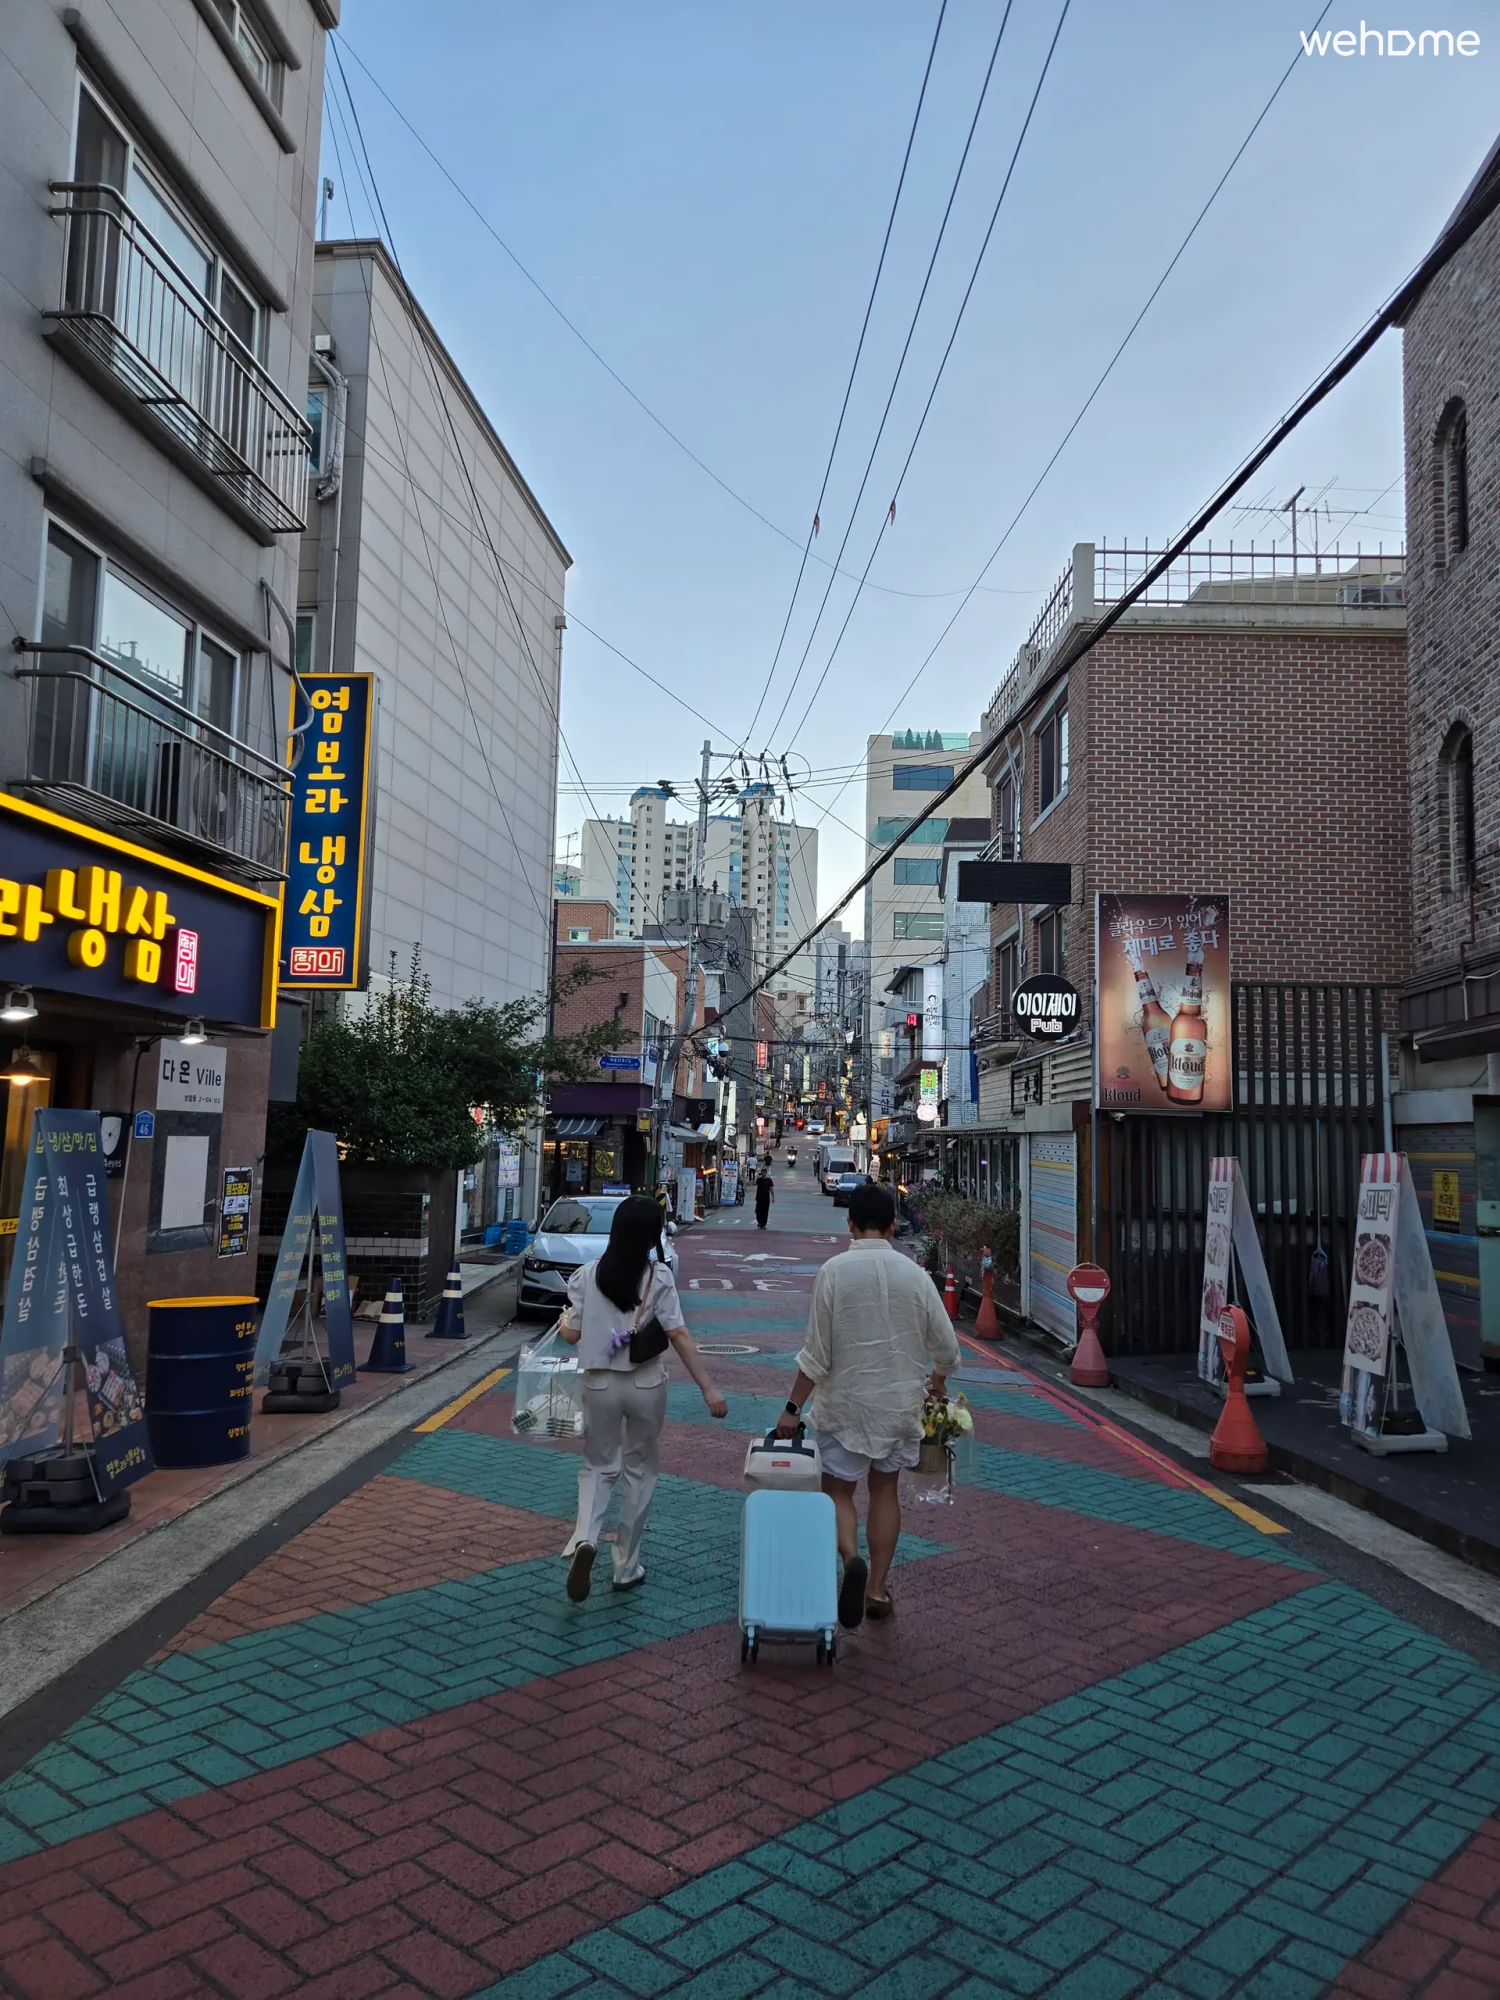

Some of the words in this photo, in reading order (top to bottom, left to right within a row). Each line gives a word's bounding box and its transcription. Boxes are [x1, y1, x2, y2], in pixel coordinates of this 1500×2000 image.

[304, 686, 350, 814] 염보라
[298, 835, 346, 937] 냉삼
[1108, 915, 1173, 938] 클라우드가
[1176, 911, 1202, 930] 있어
[1122, 934, 1177, 958] 제대로
[1183, 929, 1220, 952] 좋다
[1017, 992, 1077, 1016] 이이제이
[1030, 1018, 1062, 1033] Pub
[1171, 1056, 1204, 1073] Kloud
[196, 1067, 222, 1086] Ville
[1104, 1088, 1141, 1102] Kloud
[139, 1123, 149, 1135] 46
